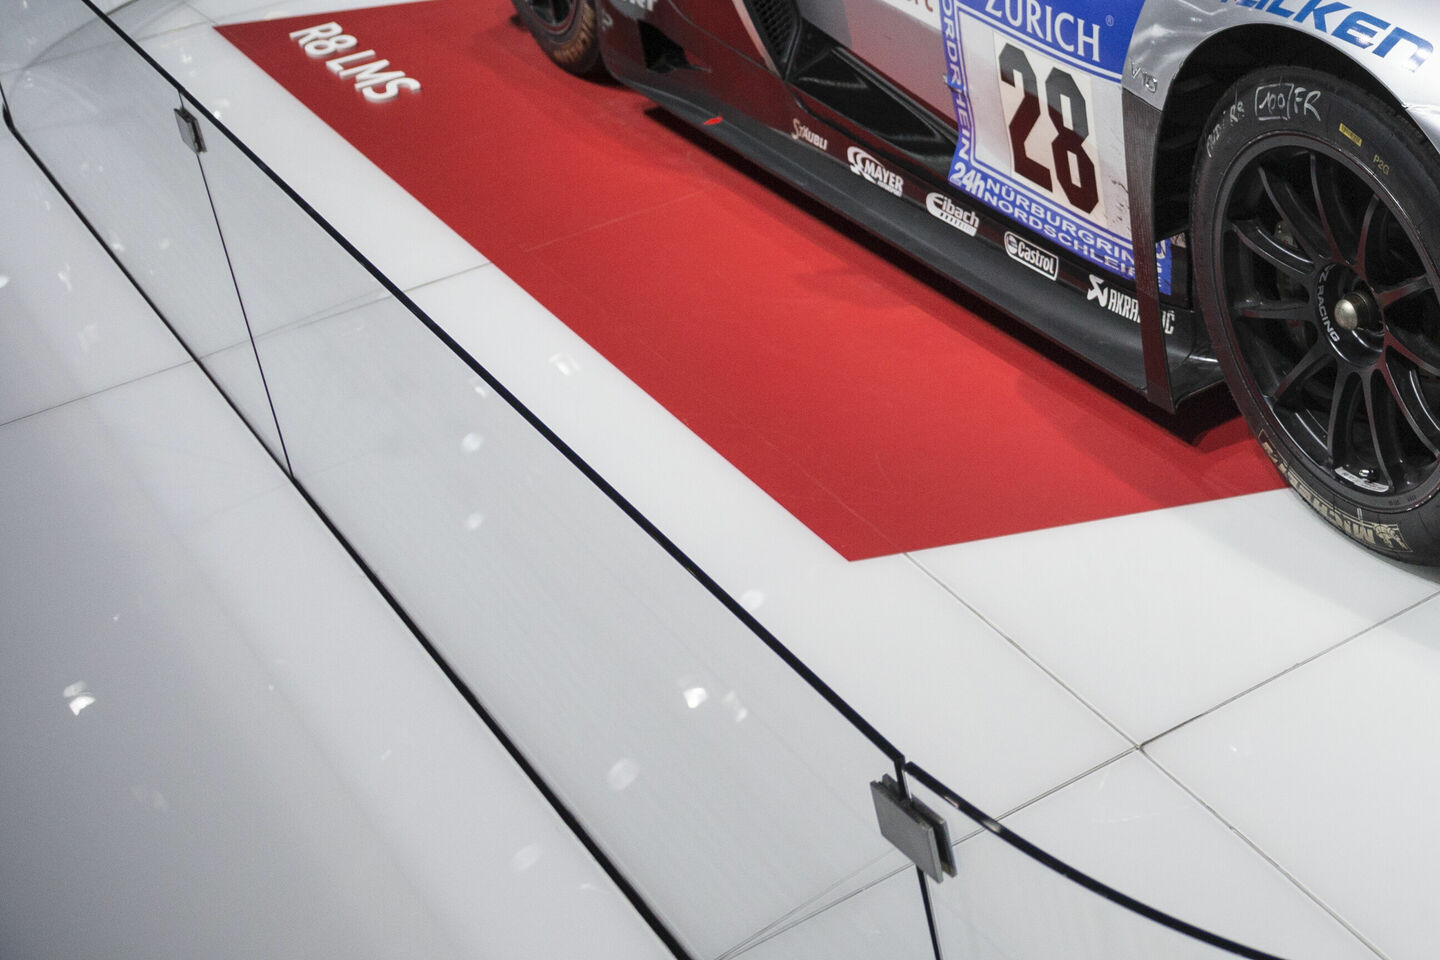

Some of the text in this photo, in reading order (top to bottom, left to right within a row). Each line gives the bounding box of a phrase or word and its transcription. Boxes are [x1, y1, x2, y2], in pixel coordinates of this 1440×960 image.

[289, 21, 422, 104] R8 LMS
[1294, 87, 1322, 122] FR
[999, 42, 1100, 215] 28
[863, 159, 904, 193] MAYER
[950, 161, 985, 199] 24h
[926, 192, 980, 228] Eibach
[984, 191, 1162, 288] NORDSCHLEIF
[1017, 240, 1055, 275] Castrol
[1317, 285, 1341, 342] RACING
